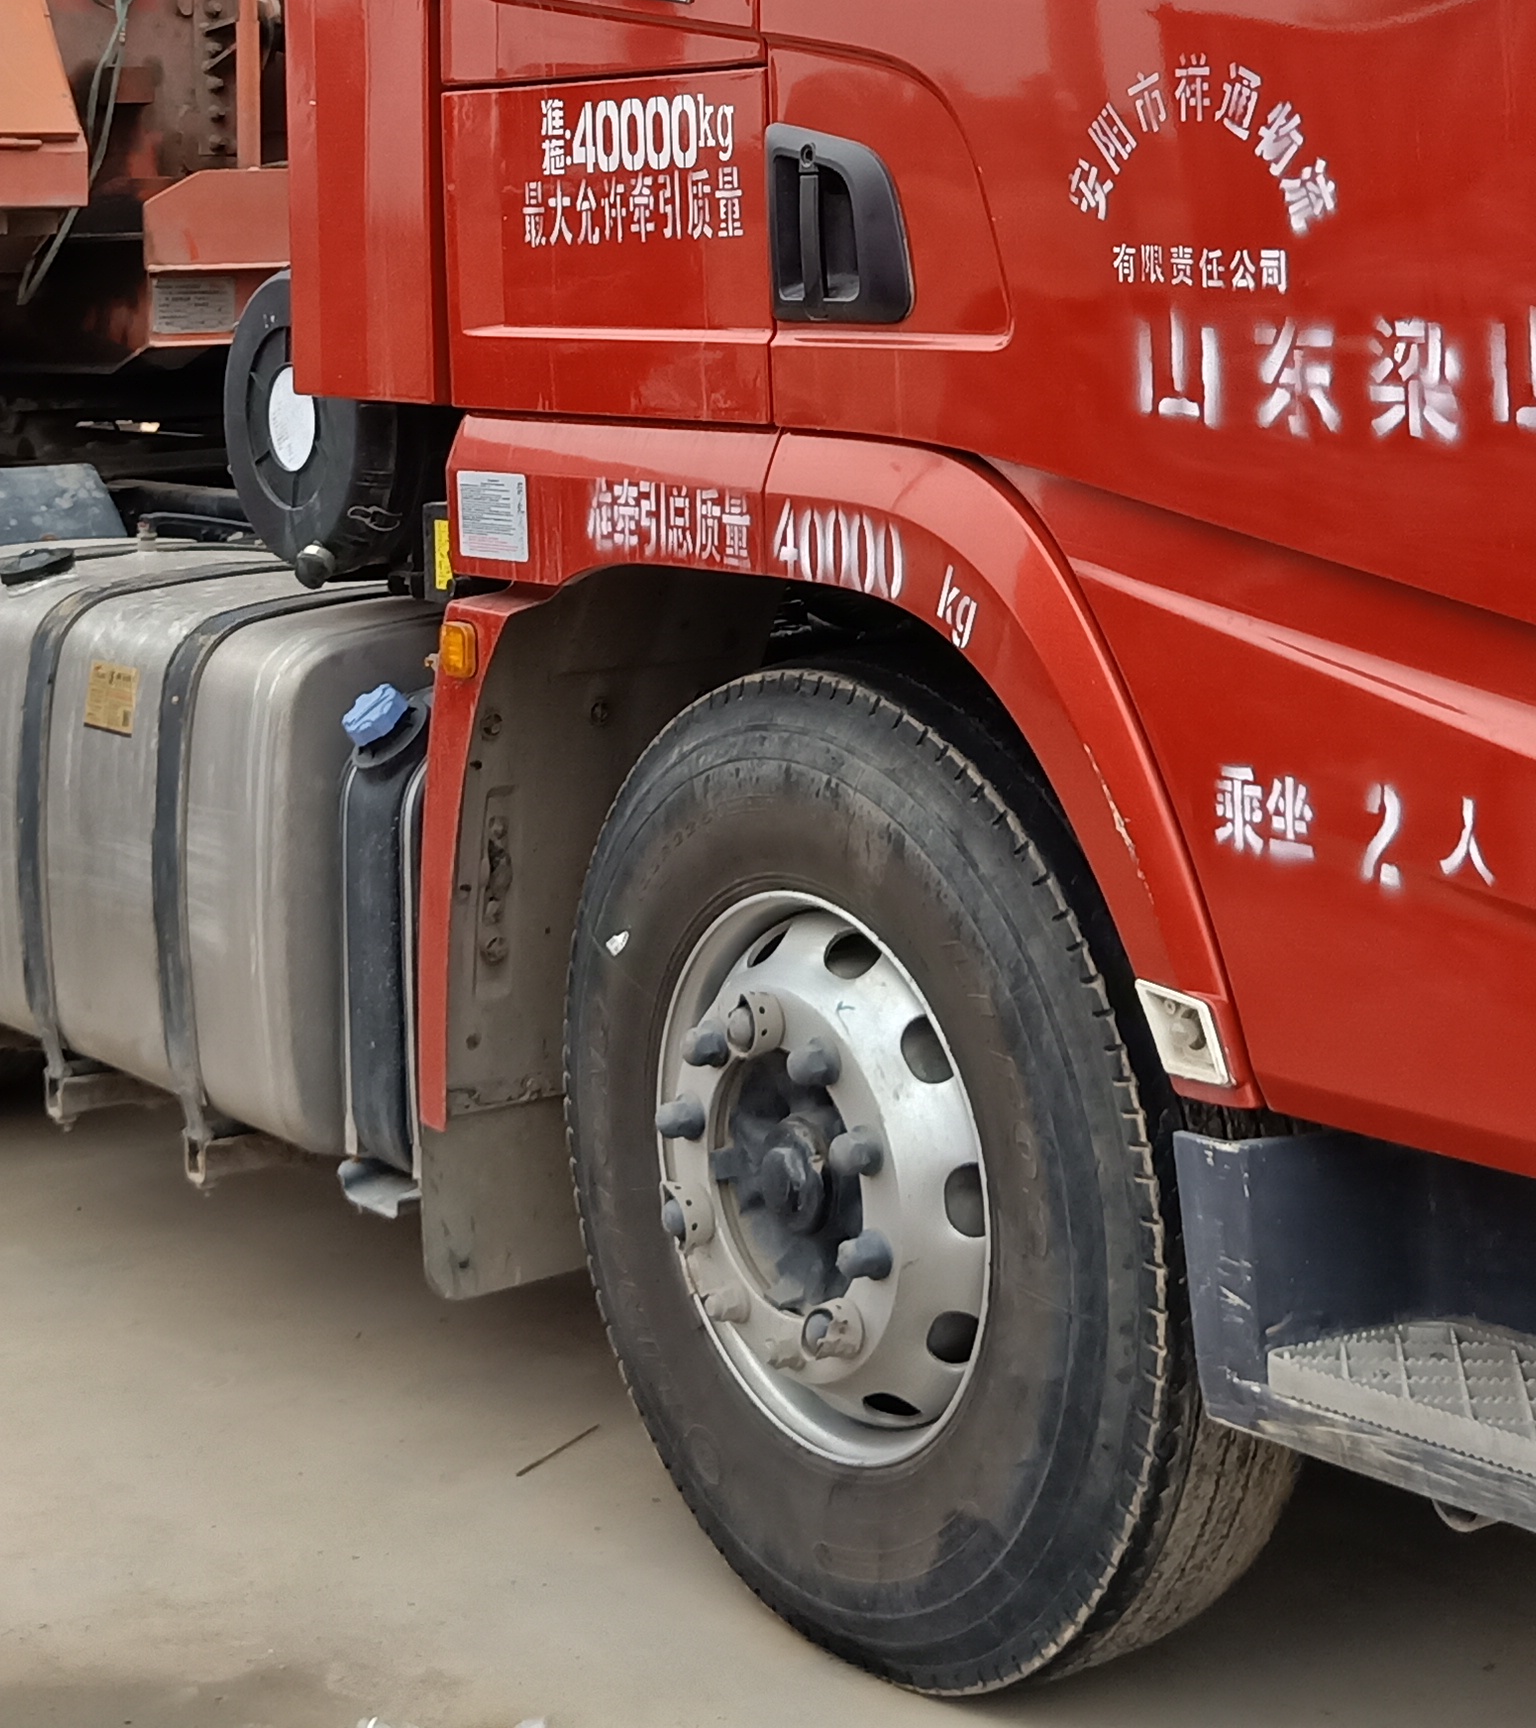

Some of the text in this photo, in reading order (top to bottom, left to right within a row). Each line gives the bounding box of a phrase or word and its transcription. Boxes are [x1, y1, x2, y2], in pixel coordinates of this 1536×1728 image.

[522, 167, 743, 248] 最大允许牵引质量
[1113, 243, 1287, 293] 有限责任公司
[936, 565, 979, 649] kg
[1362, 784, 1402, 889] 2
[1439, 796, 1495, 885] 人
